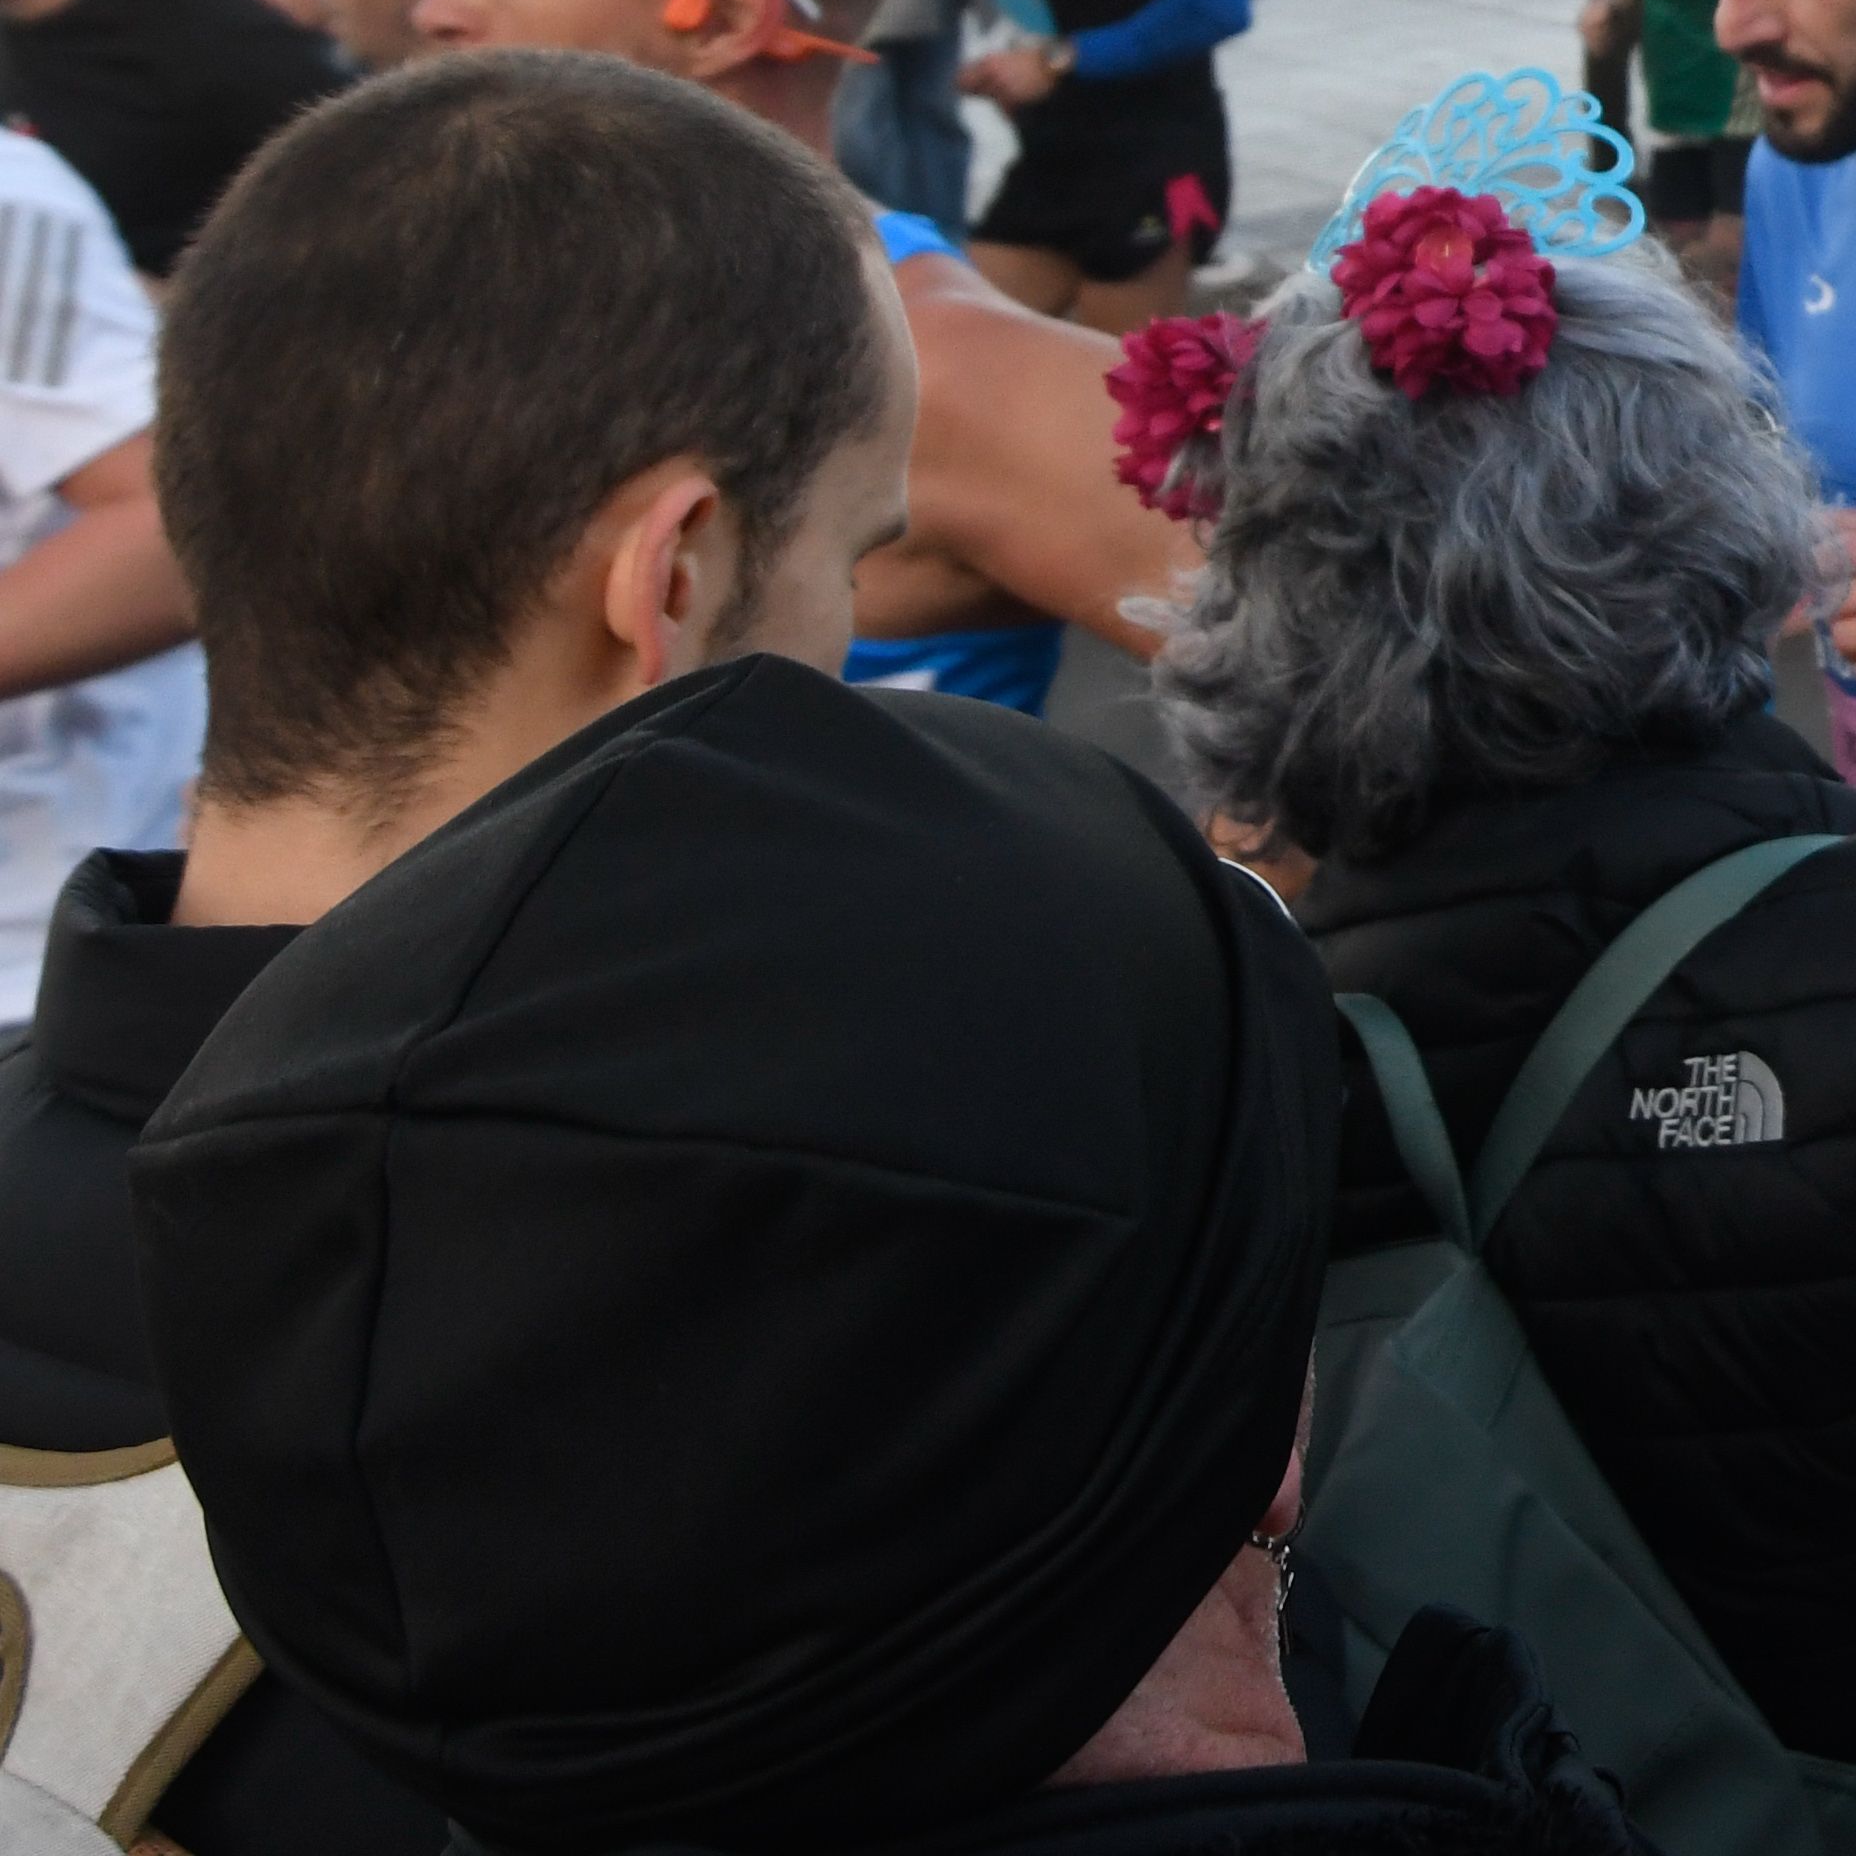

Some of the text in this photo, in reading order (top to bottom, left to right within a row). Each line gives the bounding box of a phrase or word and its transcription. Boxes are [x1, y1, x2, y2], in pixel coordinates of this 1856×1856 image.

[1683, 1052, 1738, 1086] THE
[1629, 1083, 1737, 1120] NORTH
[1658, 1114, 1734, 1149] FACE
